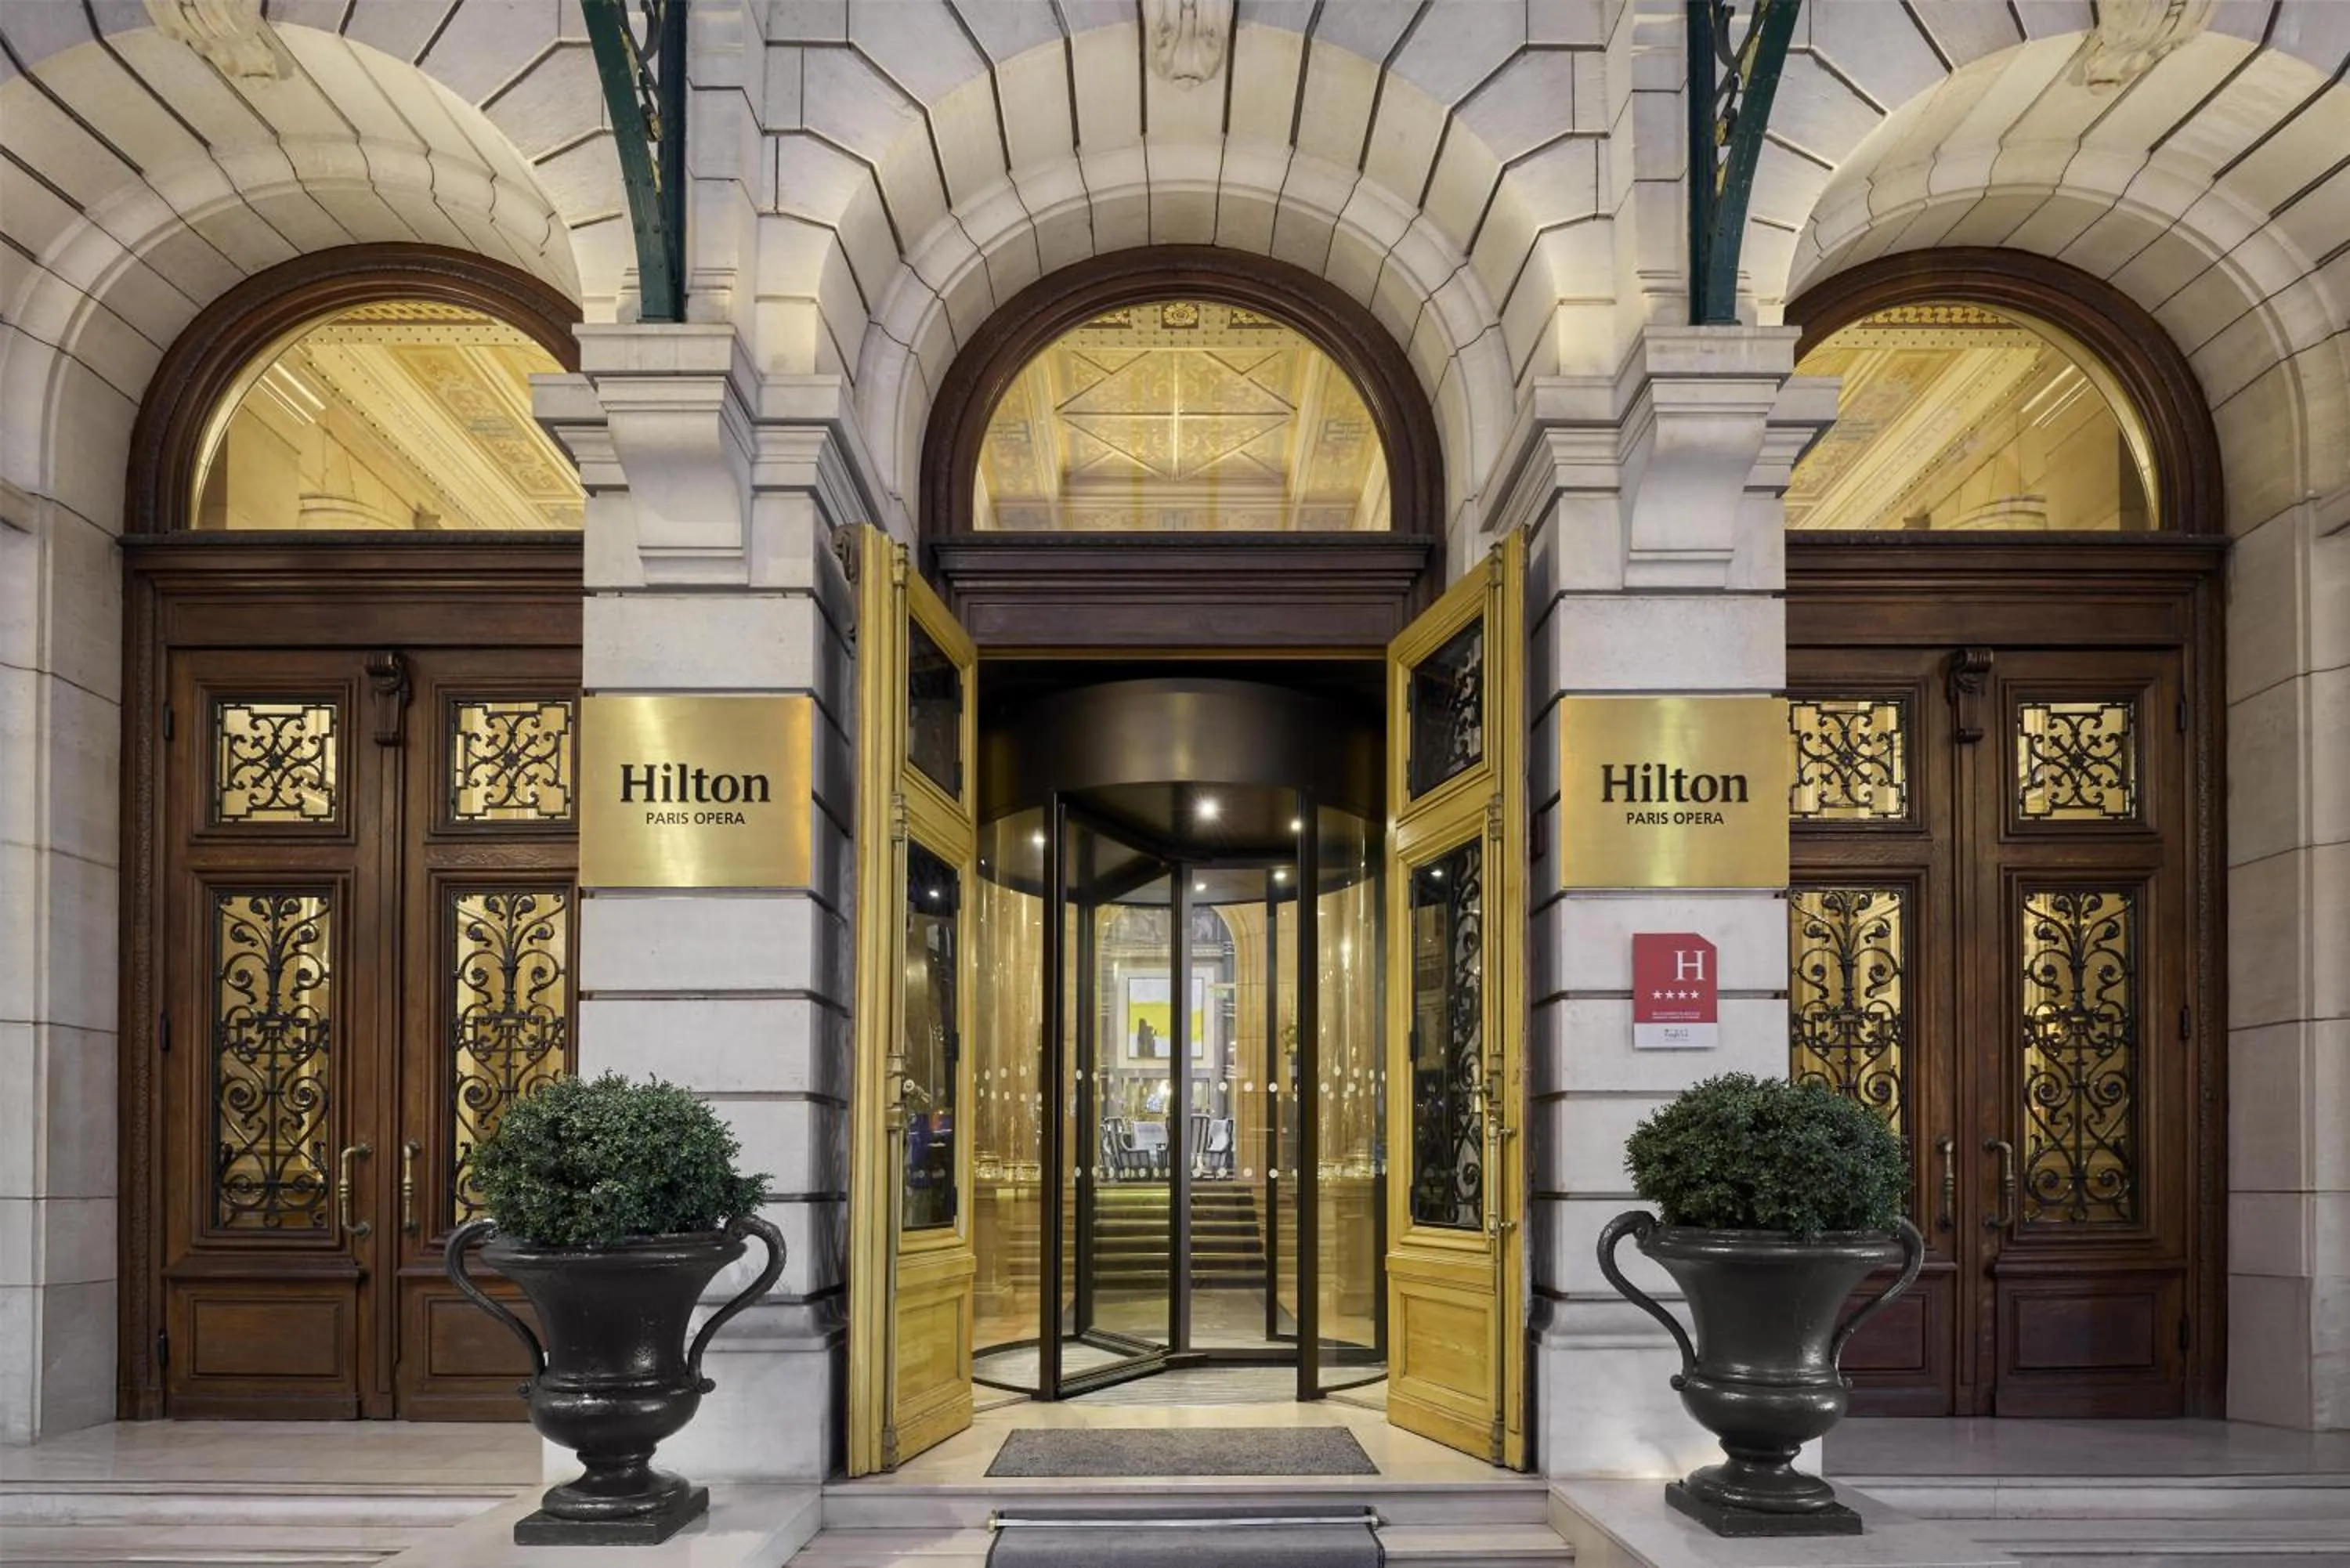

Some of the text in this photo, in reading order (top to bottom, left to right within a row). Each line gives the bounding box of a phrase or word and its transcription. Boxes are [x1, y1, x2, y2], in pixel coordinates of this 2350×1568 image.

[620, 763, 771, 804] Hilton
[1601, 762, 1749, 804] Hilton
[646, 811, 746, 825] PARIS OPERA
[1626, 811, 1725, 825] PARIS OPERA
[1673, 950, 1706, 981] H
